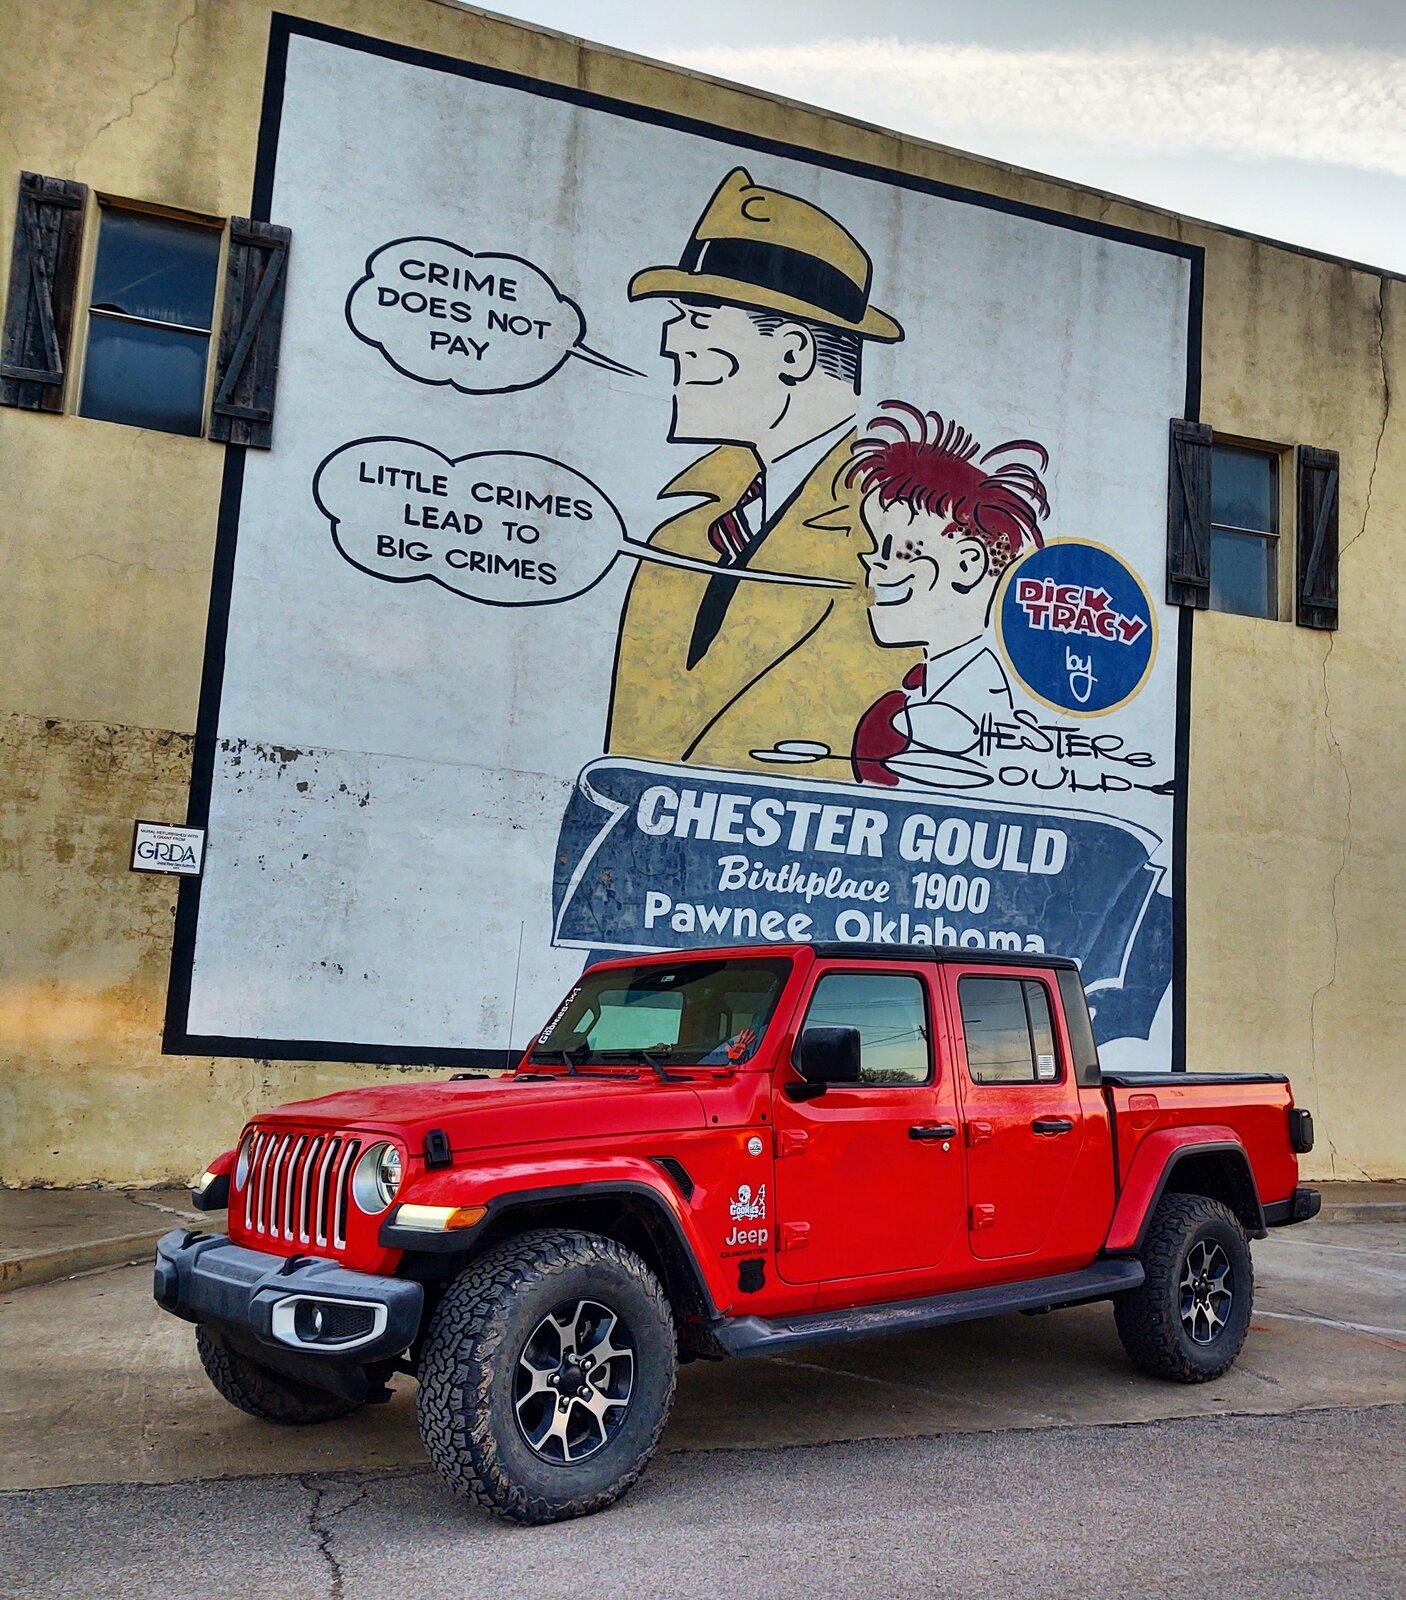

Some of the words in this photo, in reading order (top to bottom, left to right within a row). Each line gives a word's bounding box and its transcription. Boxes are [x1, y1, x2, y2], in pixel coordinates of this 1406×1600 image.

[400, 259, 517, 301] CRIME
[377, 286, 472, 323] DOES
[488, 309, 551, 340] NOT
[430, 331, 490, 360] PAY
[359, 461, 448, 497] LITTLE
[470, 482, 593, 521] CRIMES
[404, 503, 483, 535] LEAD
[501, 521, 540, 544] TO
[376, 534, 432, 561] BIG
[445, 549, 557, 586] CRIMES
[1023, 602, 1148, 646] TRACY
[1065, 645, 1098, 703] by
[137, 841, 196, 864] GRDA
[636, 785, 888, 857] CHESTER
[898, 813, 1069, 876] GOULD
[717, 855, 890, 903] Birthplace
[911, 872, 991, 914] 1900
[643, 891, 813, 942] Pawnee
[835, 909, 1045, 954] Oklahoma
[725, 1227, 769, 1246] Jeep
